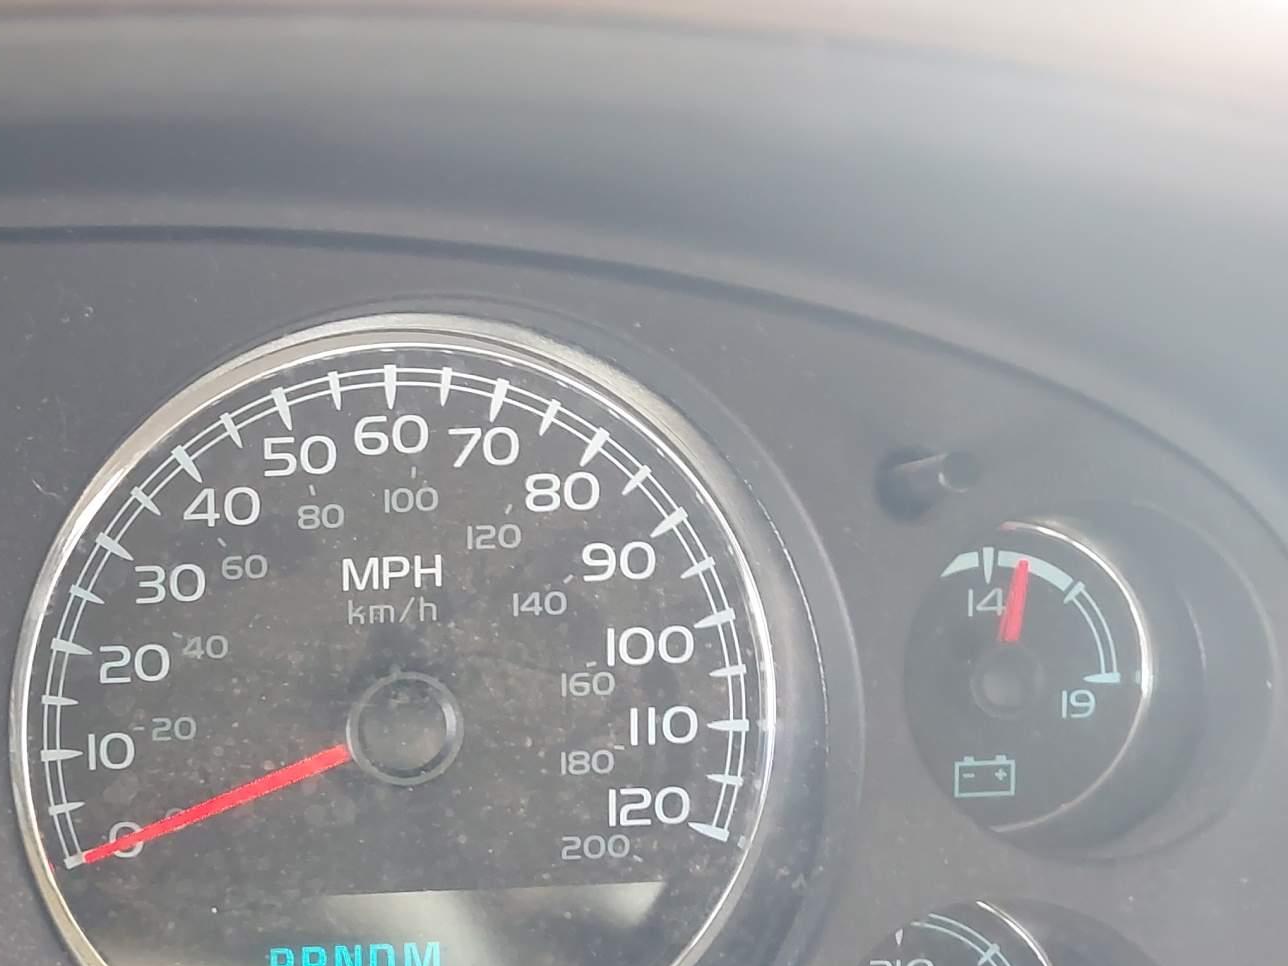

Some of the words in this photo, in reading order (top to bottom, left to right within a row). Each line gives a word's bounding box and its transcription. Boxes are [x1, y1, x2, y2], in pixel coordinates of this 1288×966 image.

[354, 415, 428, 454] 60
[448, 427, 521, 467] 70
[263, 436, 337, 476] 50
[183, 487, 261, 527] 40
[383, 487, 439, 514] 100
[525, 472, 600, 511] 80
[297, 504, 344, 531] 80
[466, 524, 522, 551] 120
[221, 554, 269, 580] 60
[342, 555, 443, 593] MPH
[582, 542, 656, 581] 90
[134, 563, 206, 603] 30
[347, 598, 439, 626] km/h
[512, 591, 568, 617] 140
[968, 588, 1007, 616] 14
[99, 643, 171, 684] 20
[181, 635, 229, 661] 40
[607, 626, 694, 667] 100
[561, 671, 616, 697] 160
[1062, 689, 1096, 719] 19
[151, 717, 197, 743] 20
[629, 705, 698, 746] 110
[87, 733, 135, 771] 10
[561, 750, 615, 776] 180
[608, 786, 691, 827] 120
[109, 821, 145, 858] 0
[561, 834, 631, 861] 200
